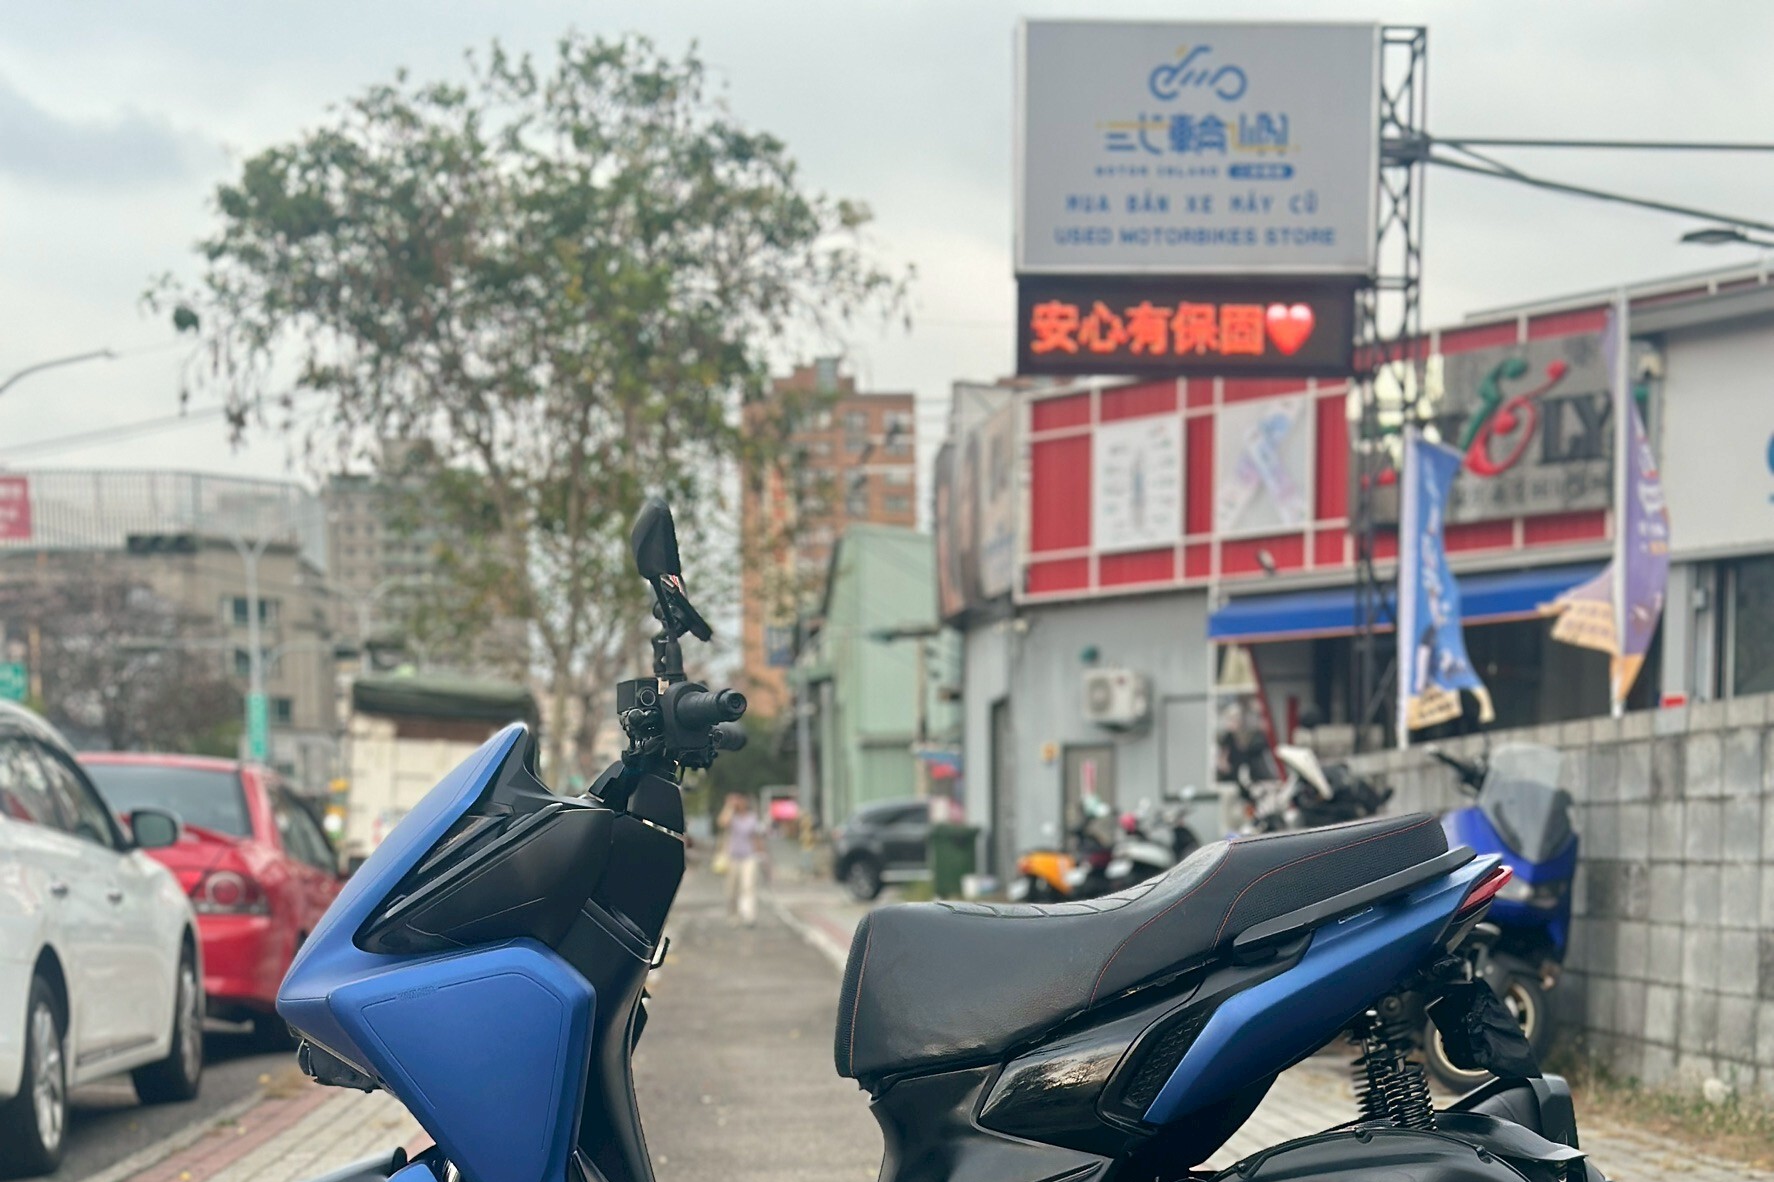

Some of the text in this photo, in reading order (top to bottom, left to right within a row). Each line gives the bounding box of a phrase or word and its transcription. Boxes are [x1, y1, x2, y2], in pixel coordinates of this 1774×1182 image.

[1186, 195, 1215, 213] XE
[1054, 228, 1336, 245] USED MOTORBIKES STORE
[1031, 300, 1265, 355] 安心有保固
